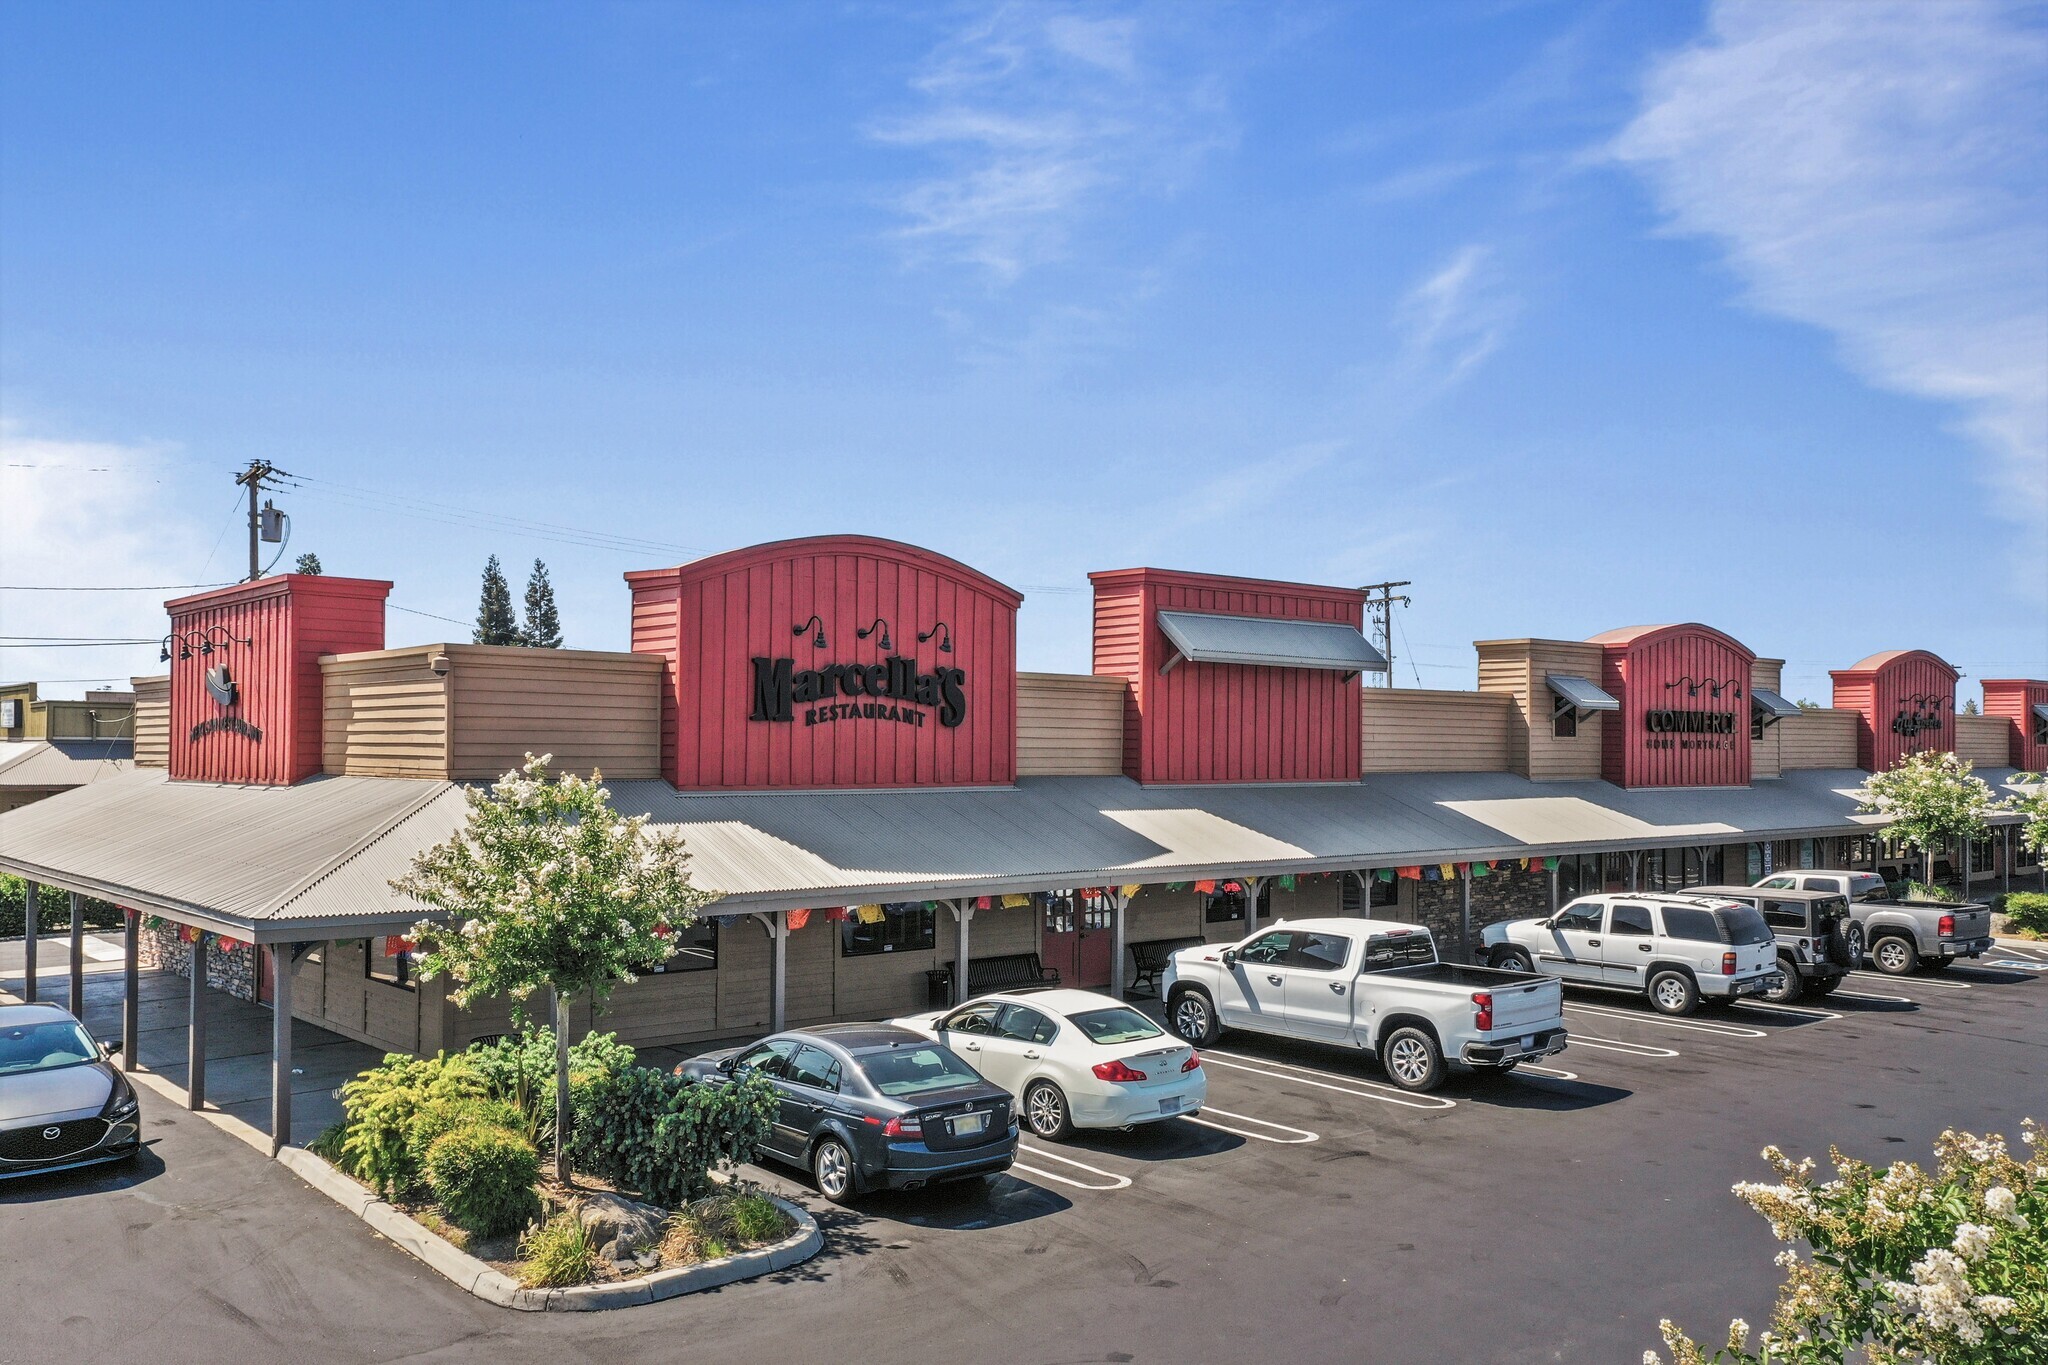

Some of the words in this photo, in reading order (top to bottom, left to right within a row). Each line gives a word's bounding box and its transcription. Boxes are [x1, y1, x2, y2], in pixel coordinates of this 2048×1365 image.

[805, 702, 926, 727] RESTAURANT
[1647, 710, 1738, 733] COMMERCE
[1681, 739, 1736, 750] MORTGAGE
